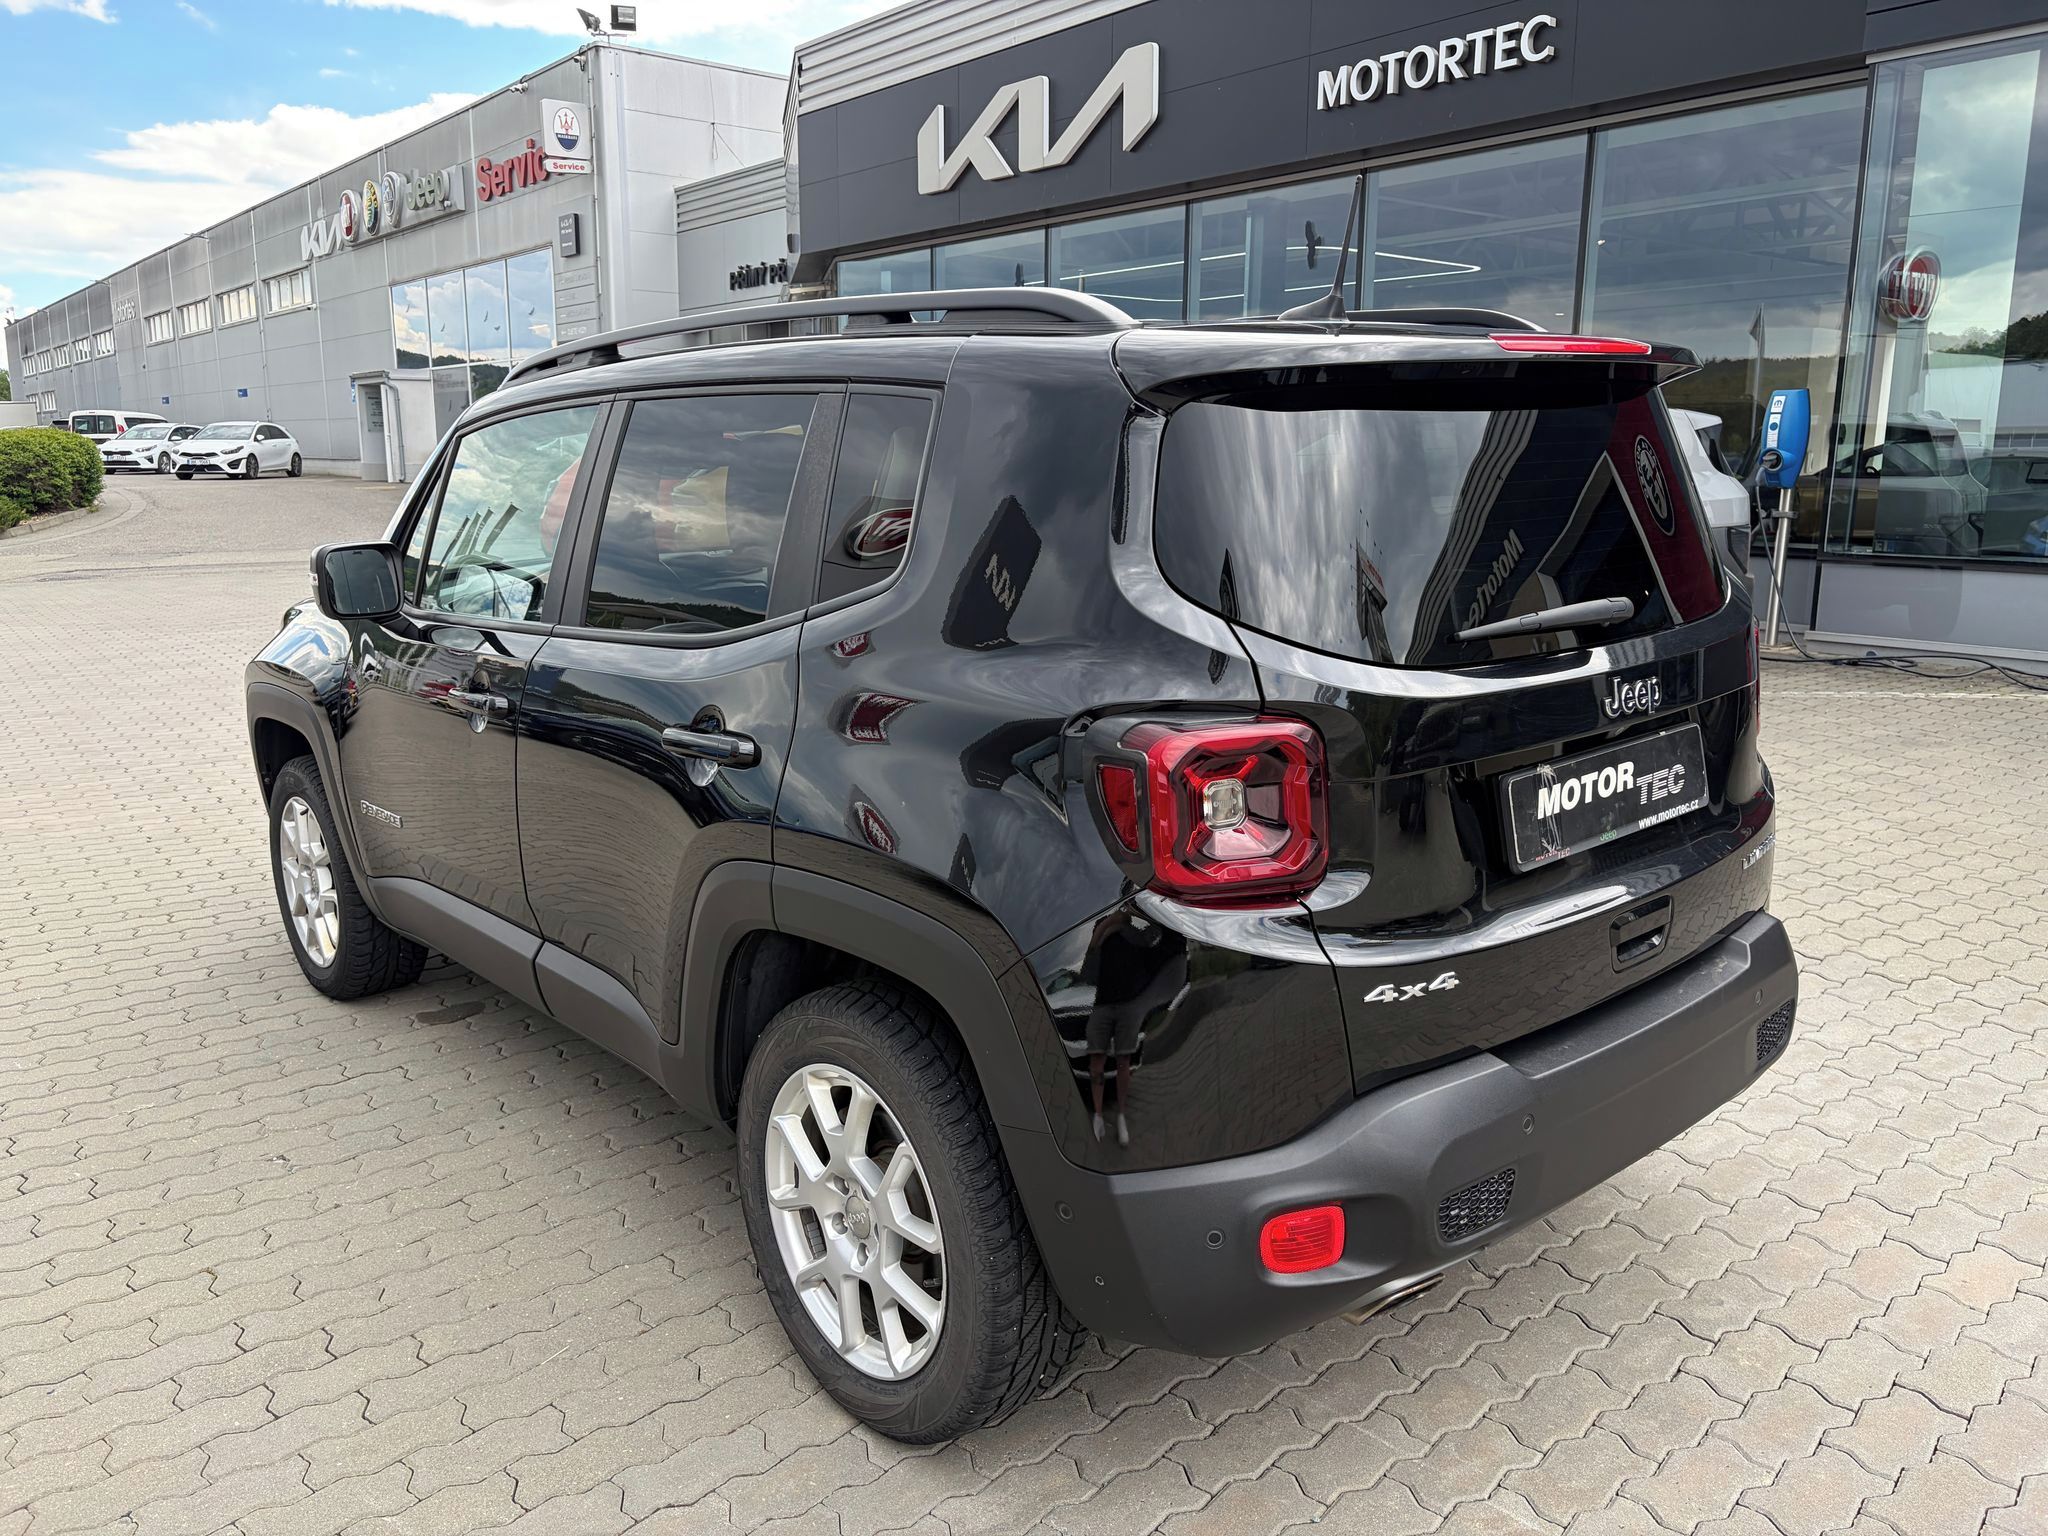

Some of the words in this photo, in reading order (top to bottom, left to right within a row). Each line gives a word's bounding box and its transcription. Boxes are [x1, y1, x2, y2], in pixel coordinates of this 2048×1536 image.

[1316, 14, 1557, 111] MOTORTEC
[917, 41, 1160, 195] KIA
[476, 138, 560, 202] Servic
[553, 162, 586, 171] Service
[405, 168, 451, 212] Jeep
[300, 212, 343, 262] KIA
[769, 257, 788, 285] PŘ
[1601, 676, 1662, 718] Jeep
[1600, 829, 1617, 841] Jeep
[1638, 799, 1699, 829] www.motortec.cz
[1363, 971, 1460, 1003] 4x4
